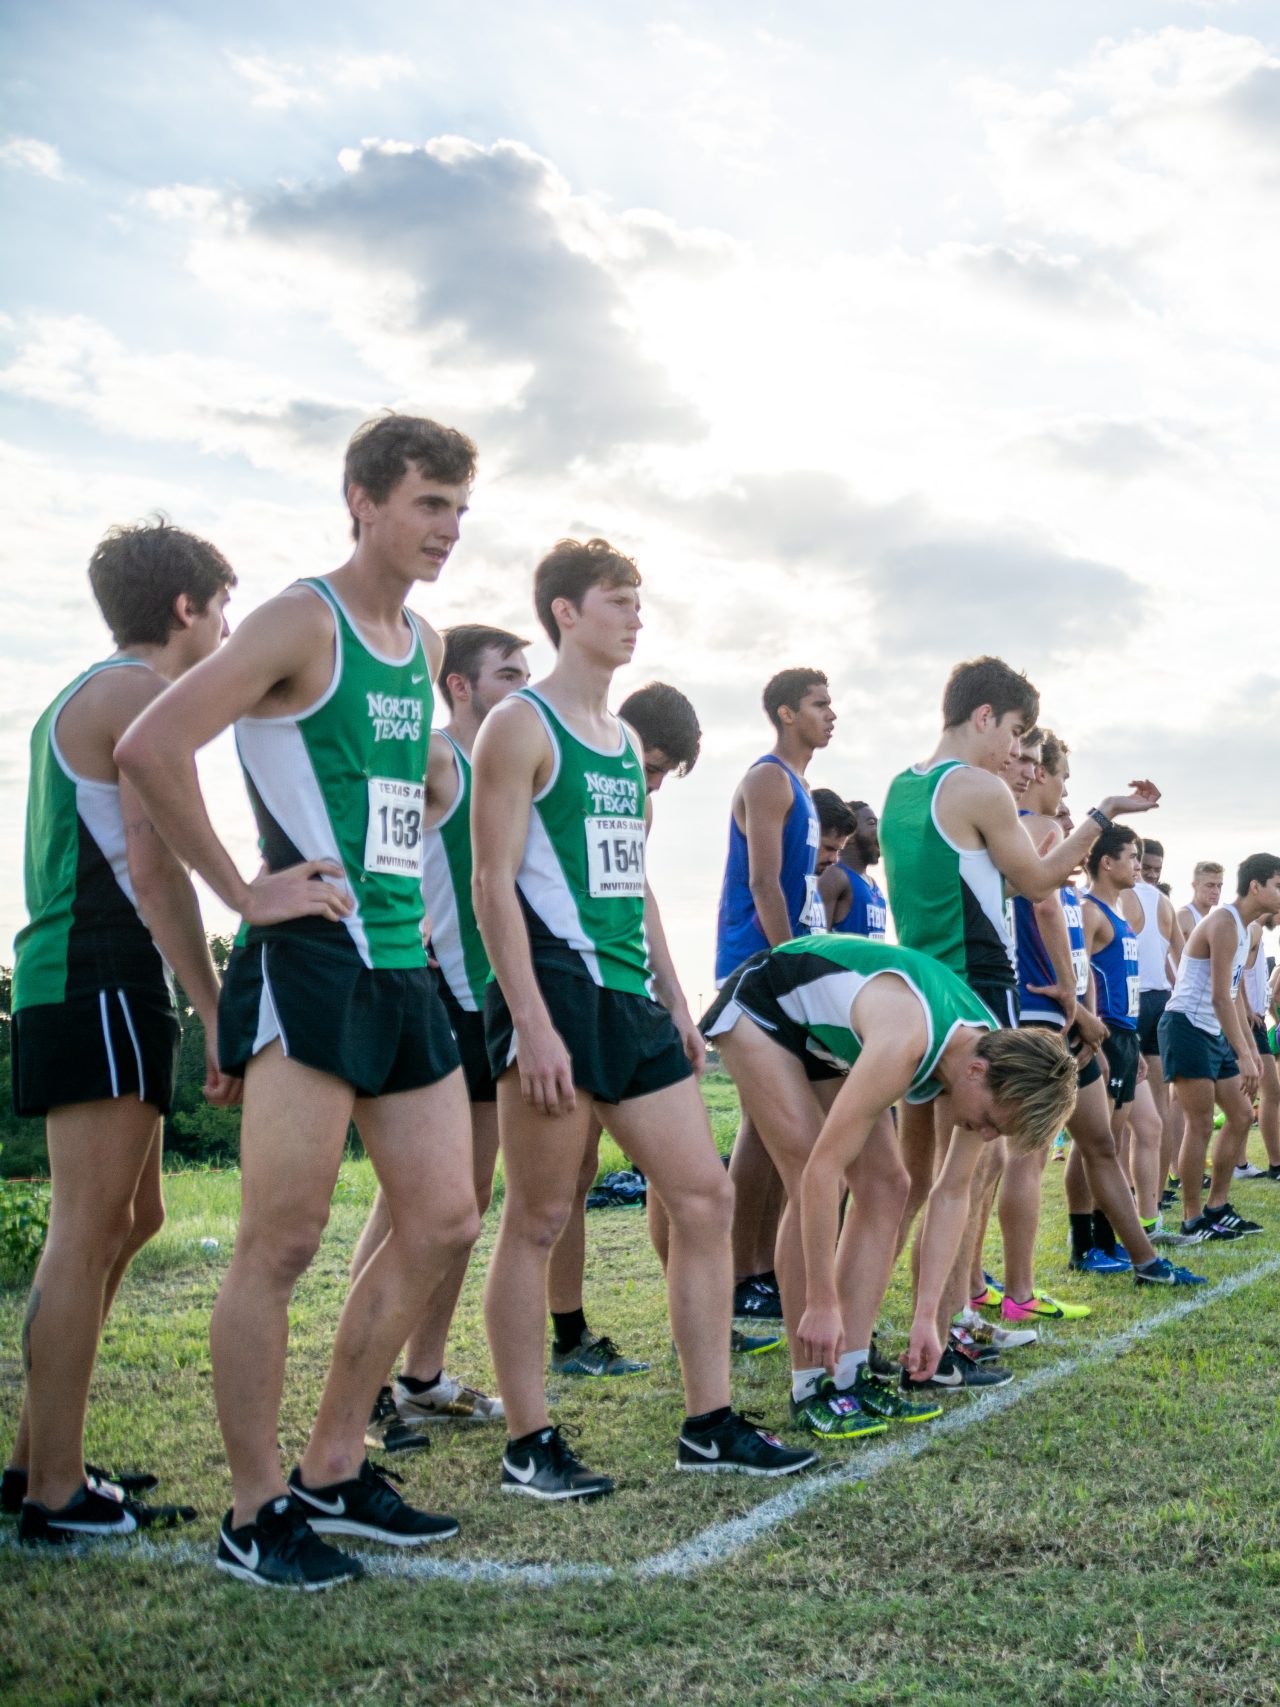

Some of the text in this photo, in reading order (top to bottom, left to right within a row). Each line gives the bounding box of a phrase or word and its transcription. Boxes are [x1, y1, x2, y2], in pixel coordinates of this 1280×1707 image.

[367, 692, 422, 720] NORTH
[372, 719, 421, 742] TEXAS
[379, 783, 424, 799] TEXAS A
[584, 771, 638, 798] NORTH
[591, 793, 637, 815] TEXAS
[378, 805, 422, 849] 153
[597, 820, 628, 830] TEXAS
